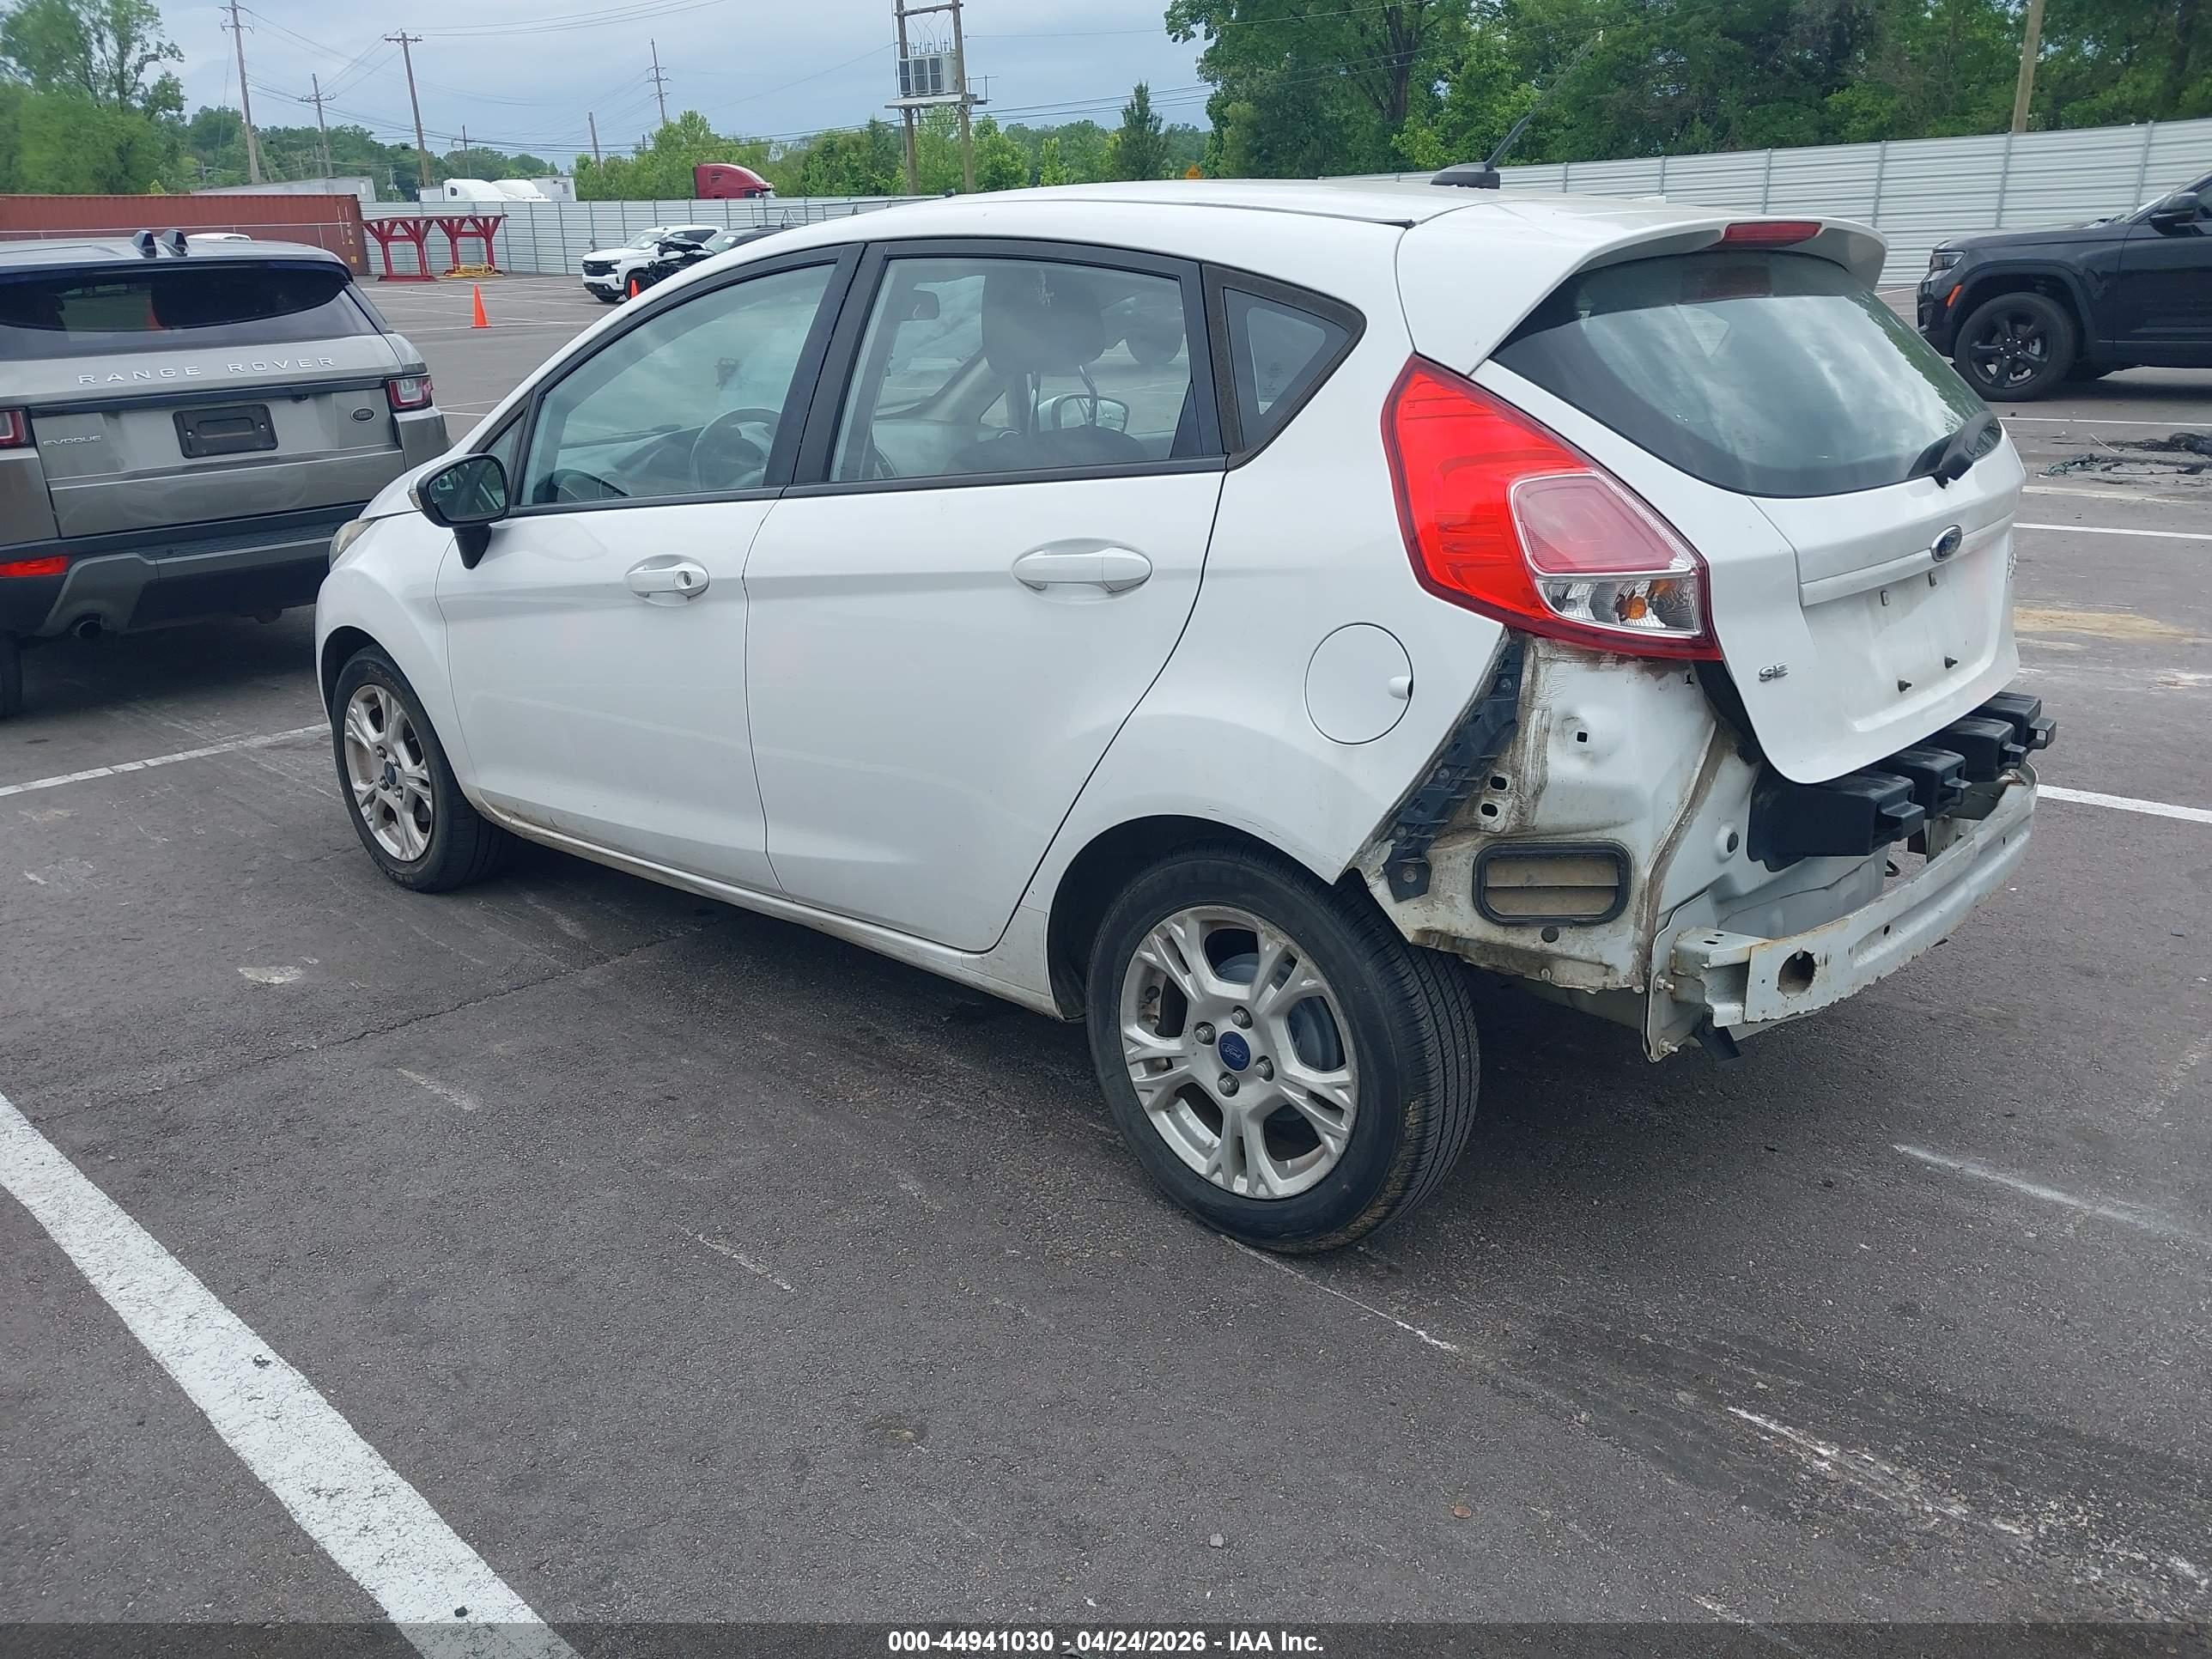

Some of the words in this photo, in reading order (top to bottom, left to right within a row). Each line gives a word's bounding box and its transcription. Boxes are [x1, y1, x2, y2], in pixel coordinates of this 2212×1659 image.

[77, 367, 202, 385] RANGE
[227, 357, 334, 373] ROVER
[42, 434, 102, 447] EVOQUE
[1759, 662, 1789, 683] SE
[1224, 1045, 1243, 1059] Ford
